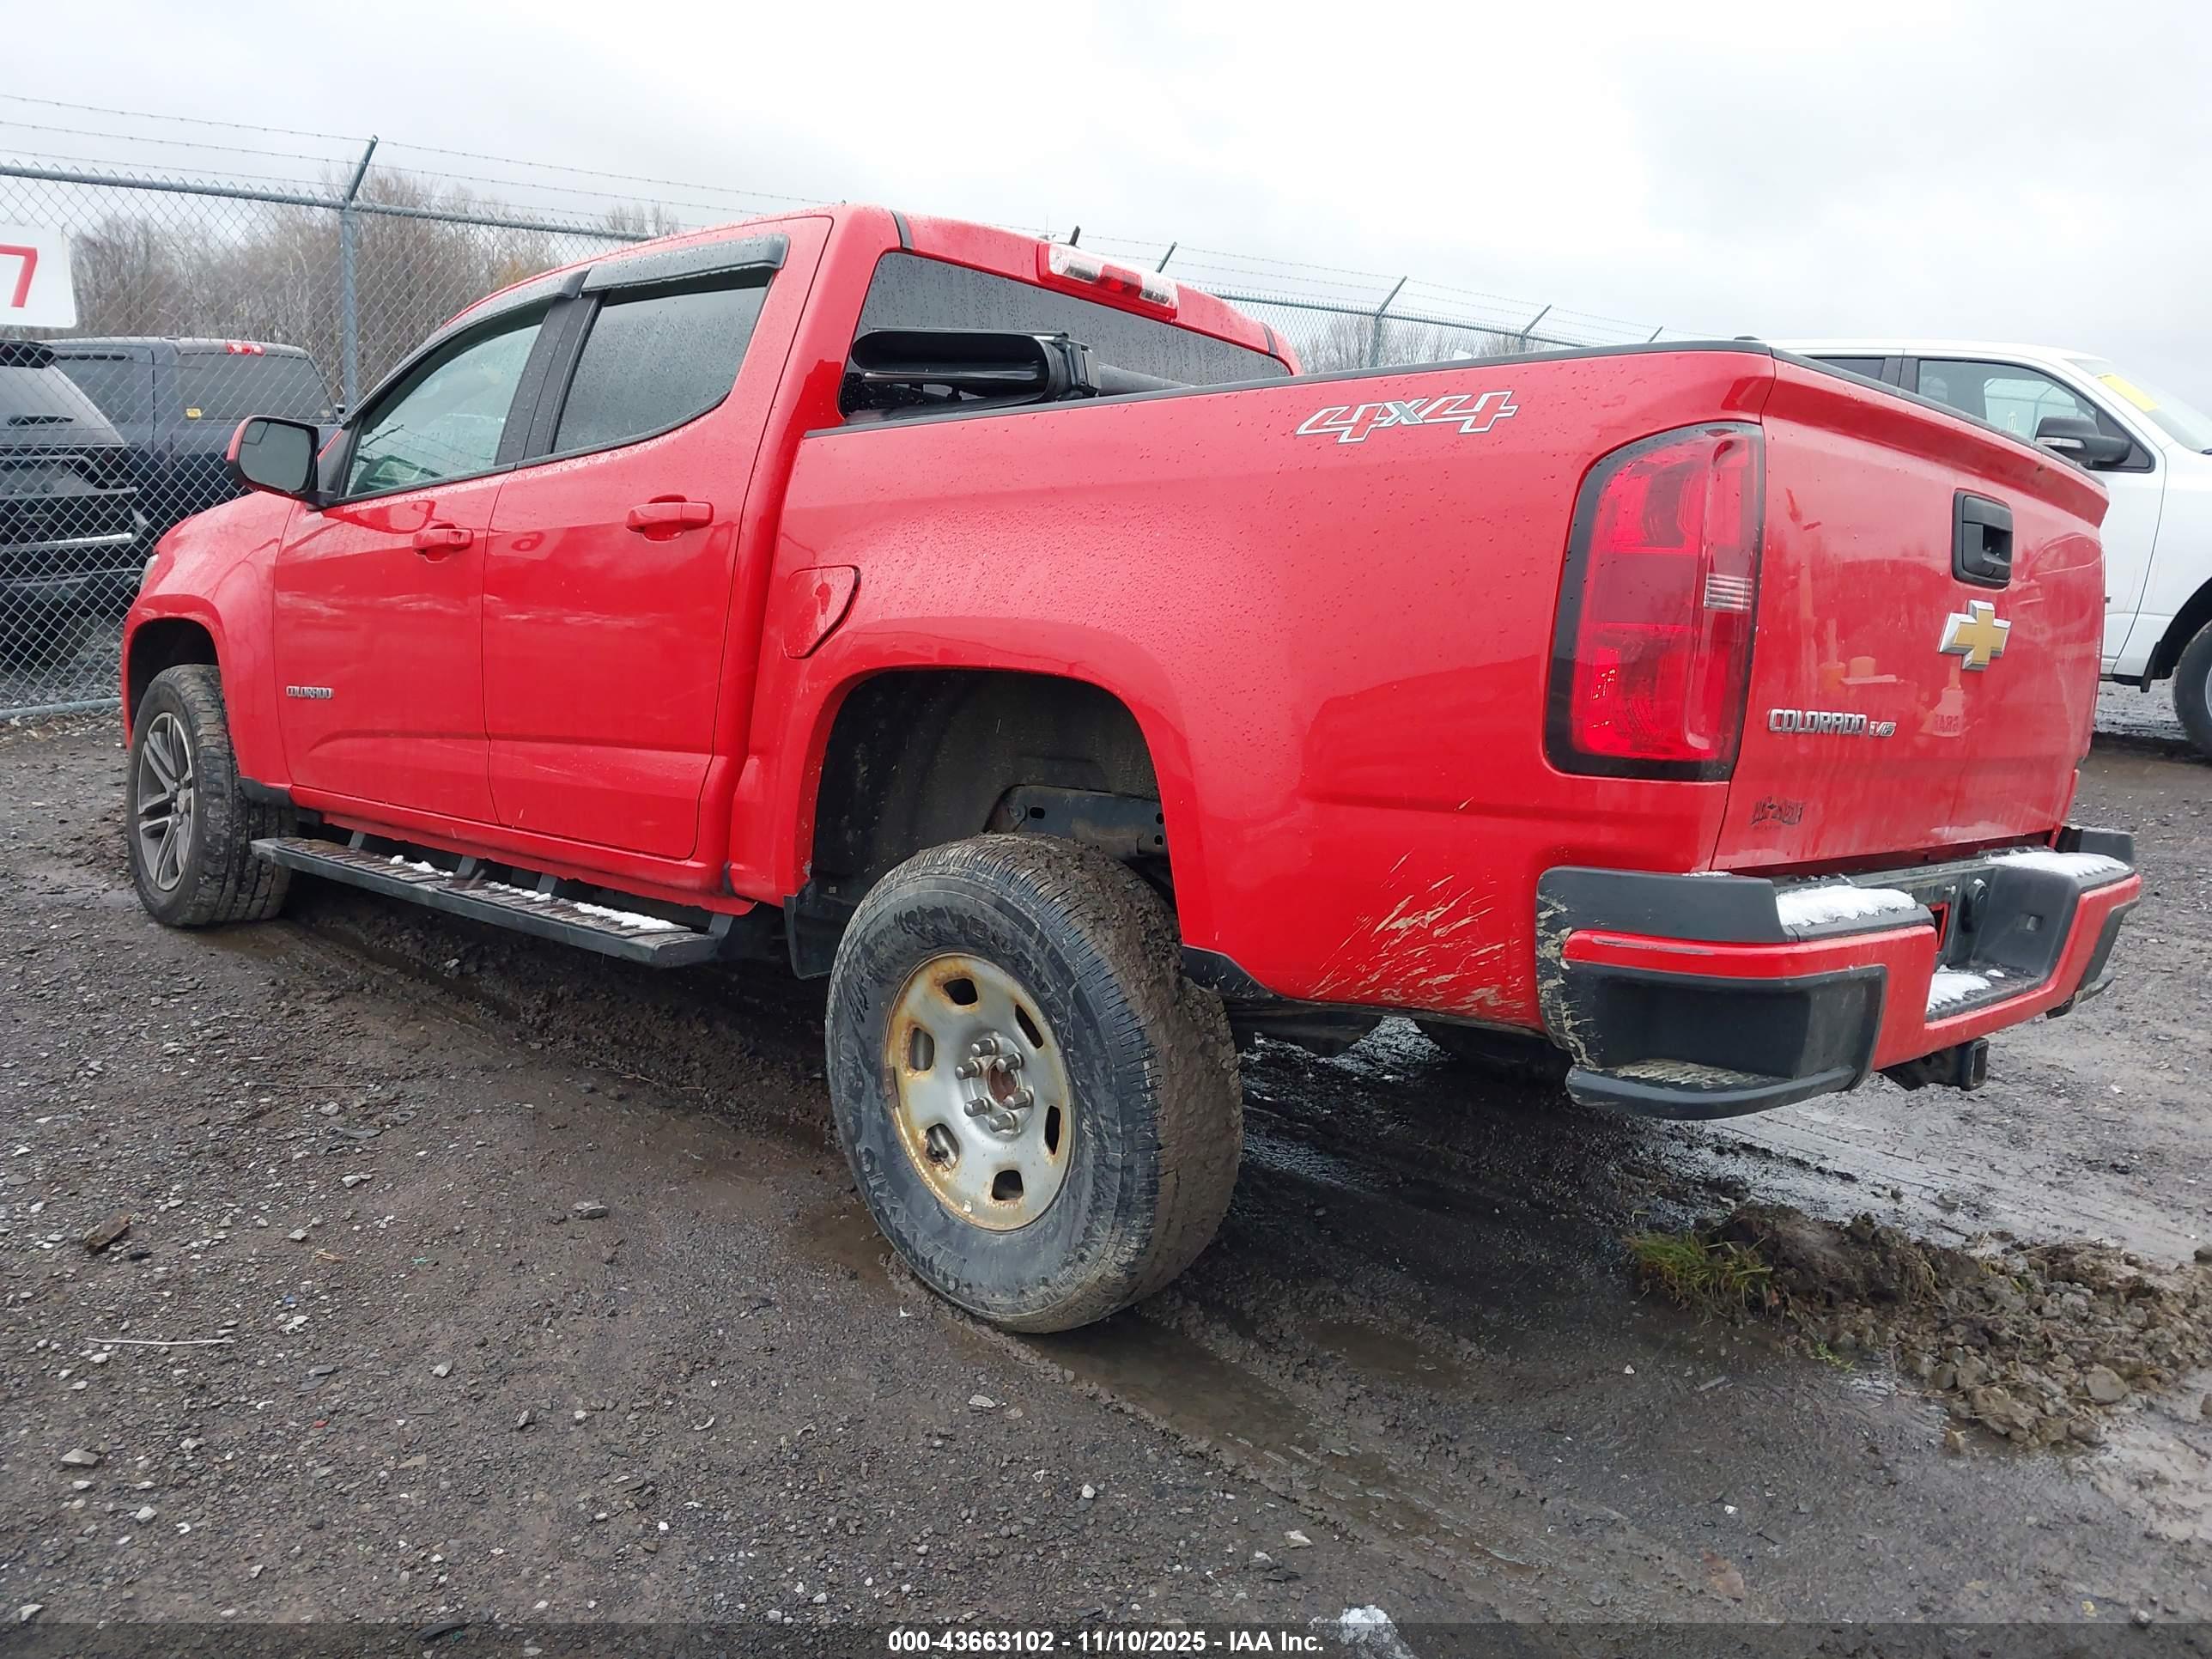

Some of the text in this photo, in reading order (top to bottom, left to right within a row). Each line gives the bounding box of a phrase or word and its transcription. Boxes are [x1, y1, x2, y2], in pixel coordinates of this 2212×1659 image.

[1296, 390, 1519, 444] 4x4
[1768, 708, 1897, 737] COLORADO V6
